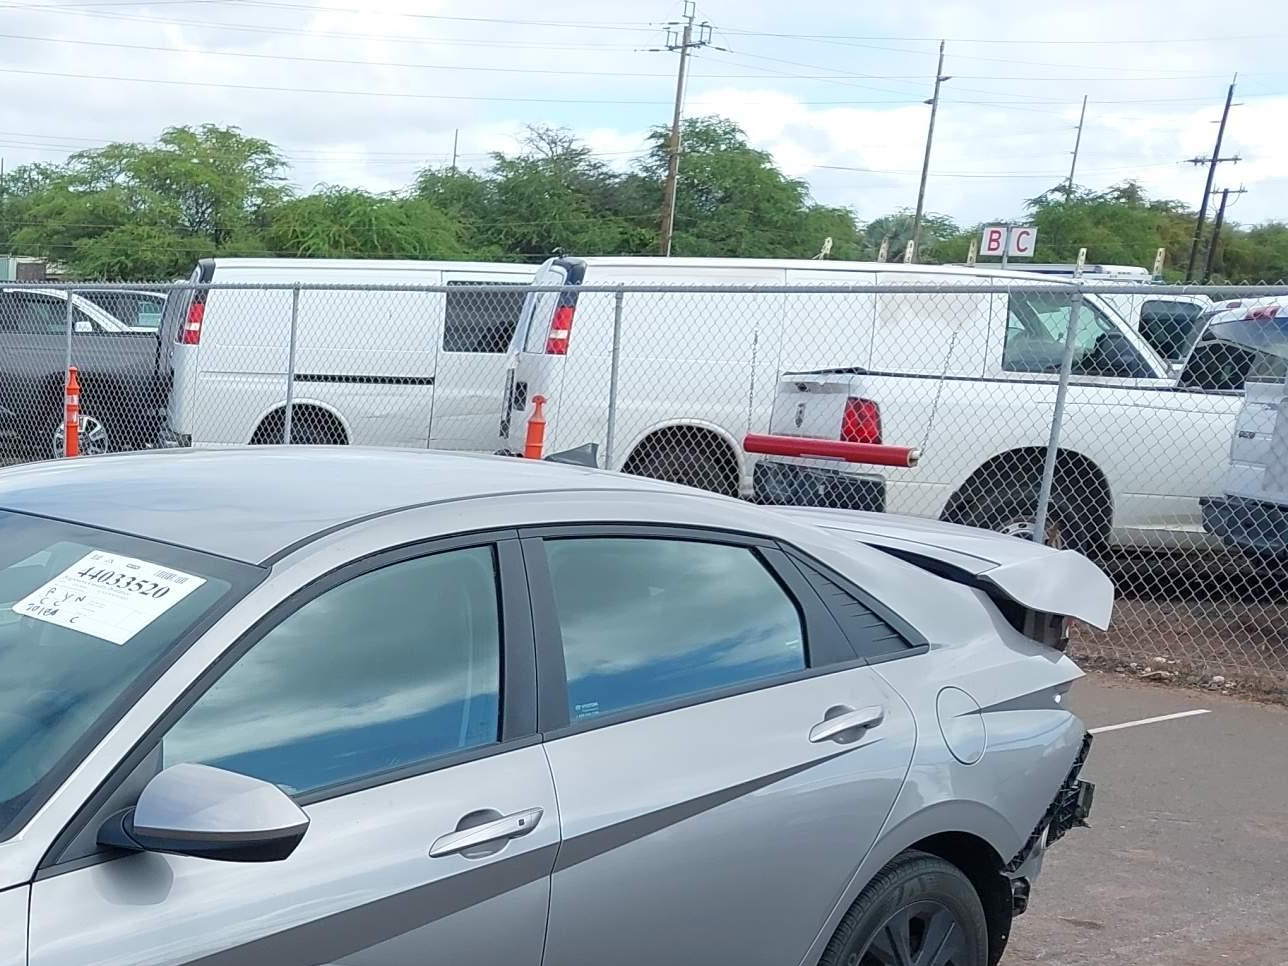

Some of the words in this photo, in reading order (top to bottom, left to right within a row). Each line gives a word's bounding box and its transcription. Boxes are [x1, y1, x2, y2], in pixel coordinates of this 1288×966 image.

[987, 230, 1002, 252] B
[1016, 230, 1031, 252] C
[78, 566, 170, 599] 44033520
